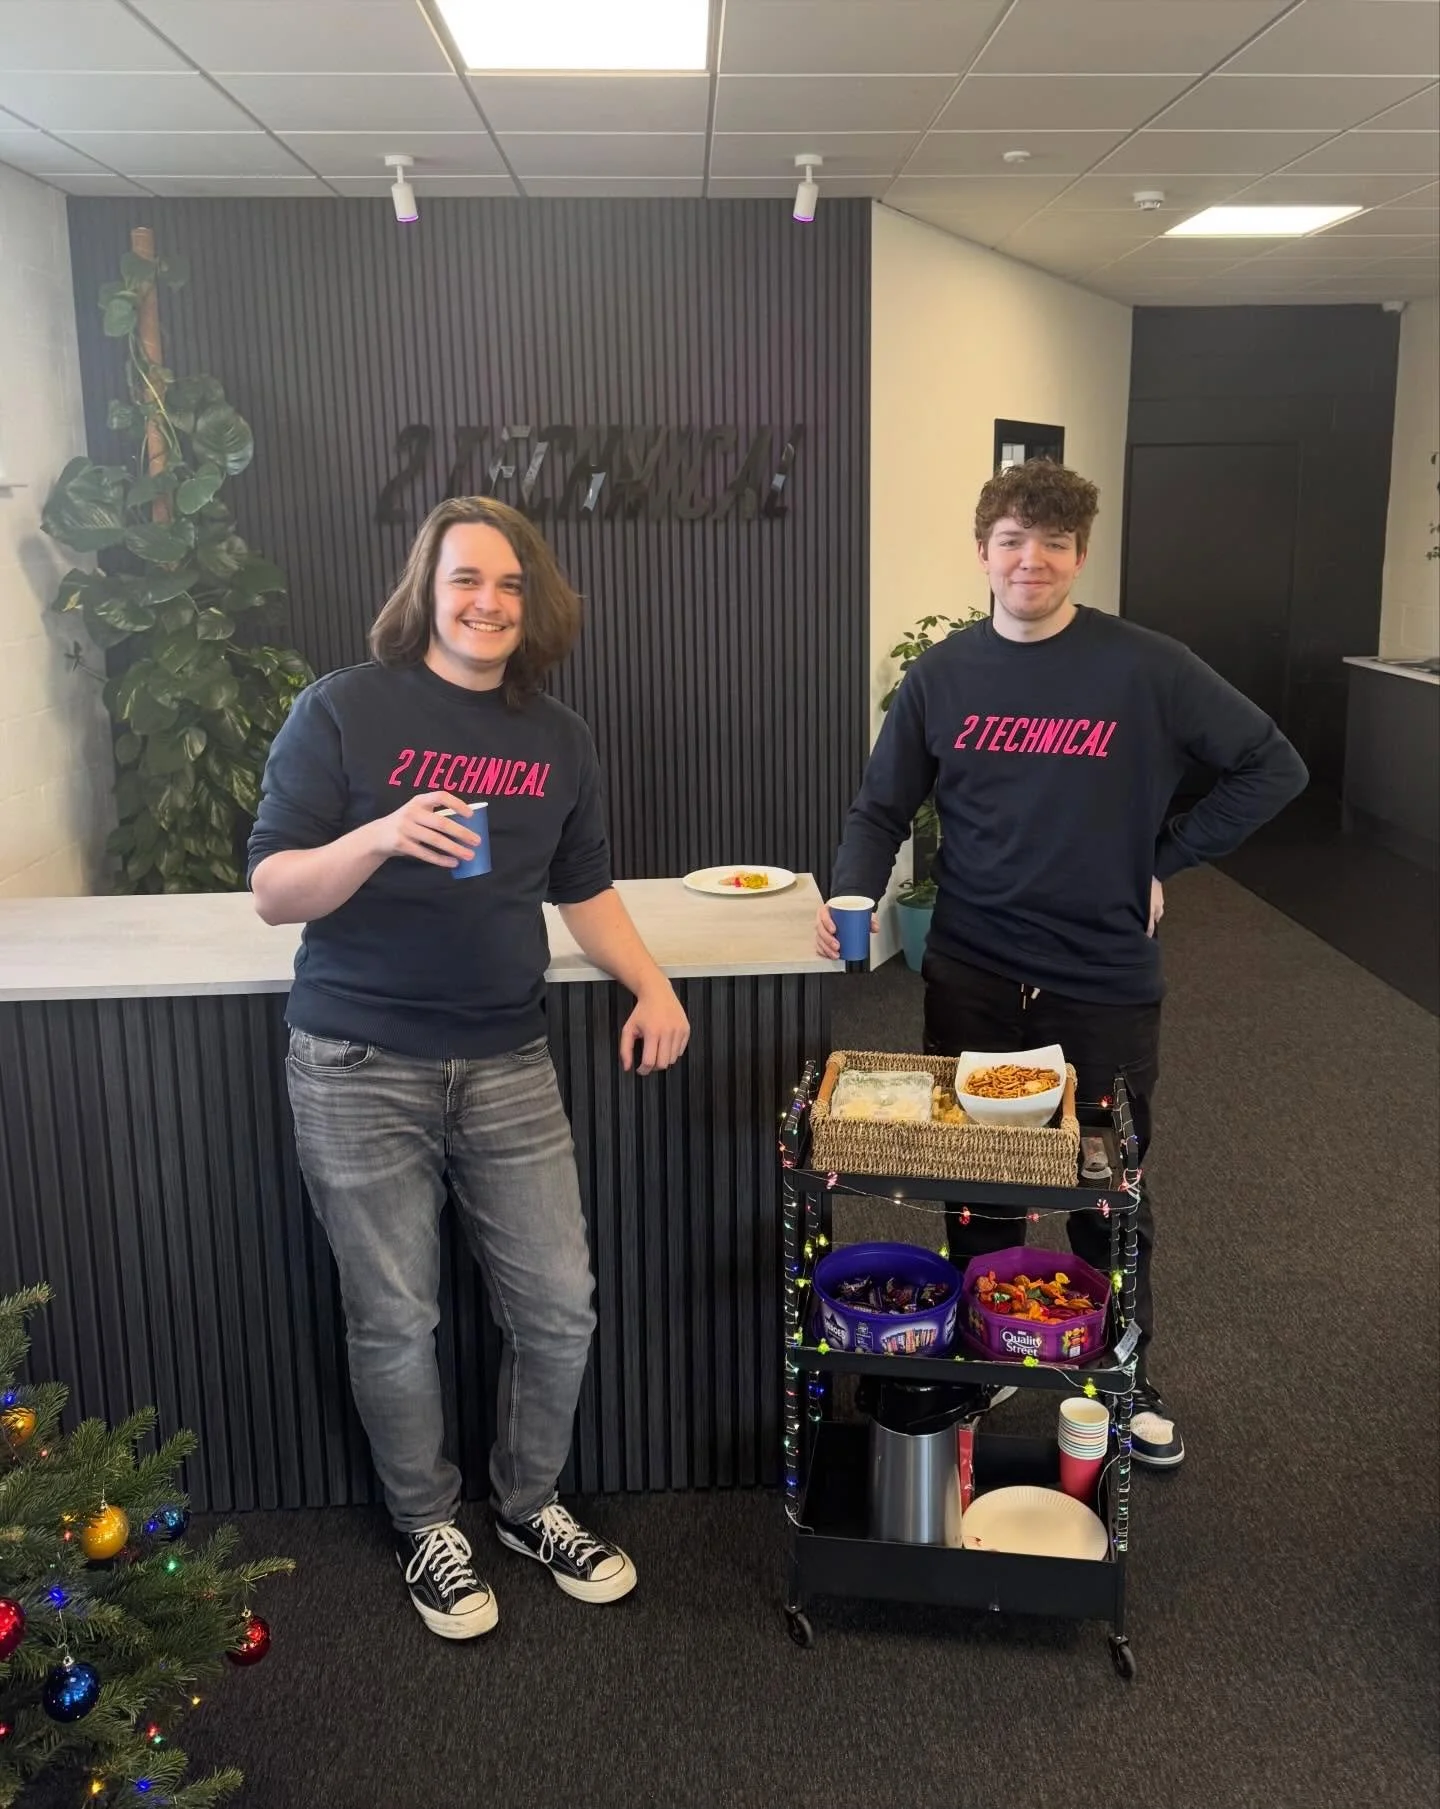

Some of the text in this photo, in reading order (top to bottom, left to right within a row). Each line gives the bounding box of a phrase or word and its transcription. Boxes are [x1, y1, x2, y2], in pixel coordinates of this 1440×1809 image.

[375, 424, 805, 521] 2 TECHNICAL
[954, 715, 1117, 757] 2 TECHNICAL
[388, 749, 551, 797] 2 TECHNICAL
[1002, 1331, 1042, 1348] Quality
[1006, 1341, 1038, 1357] Street
